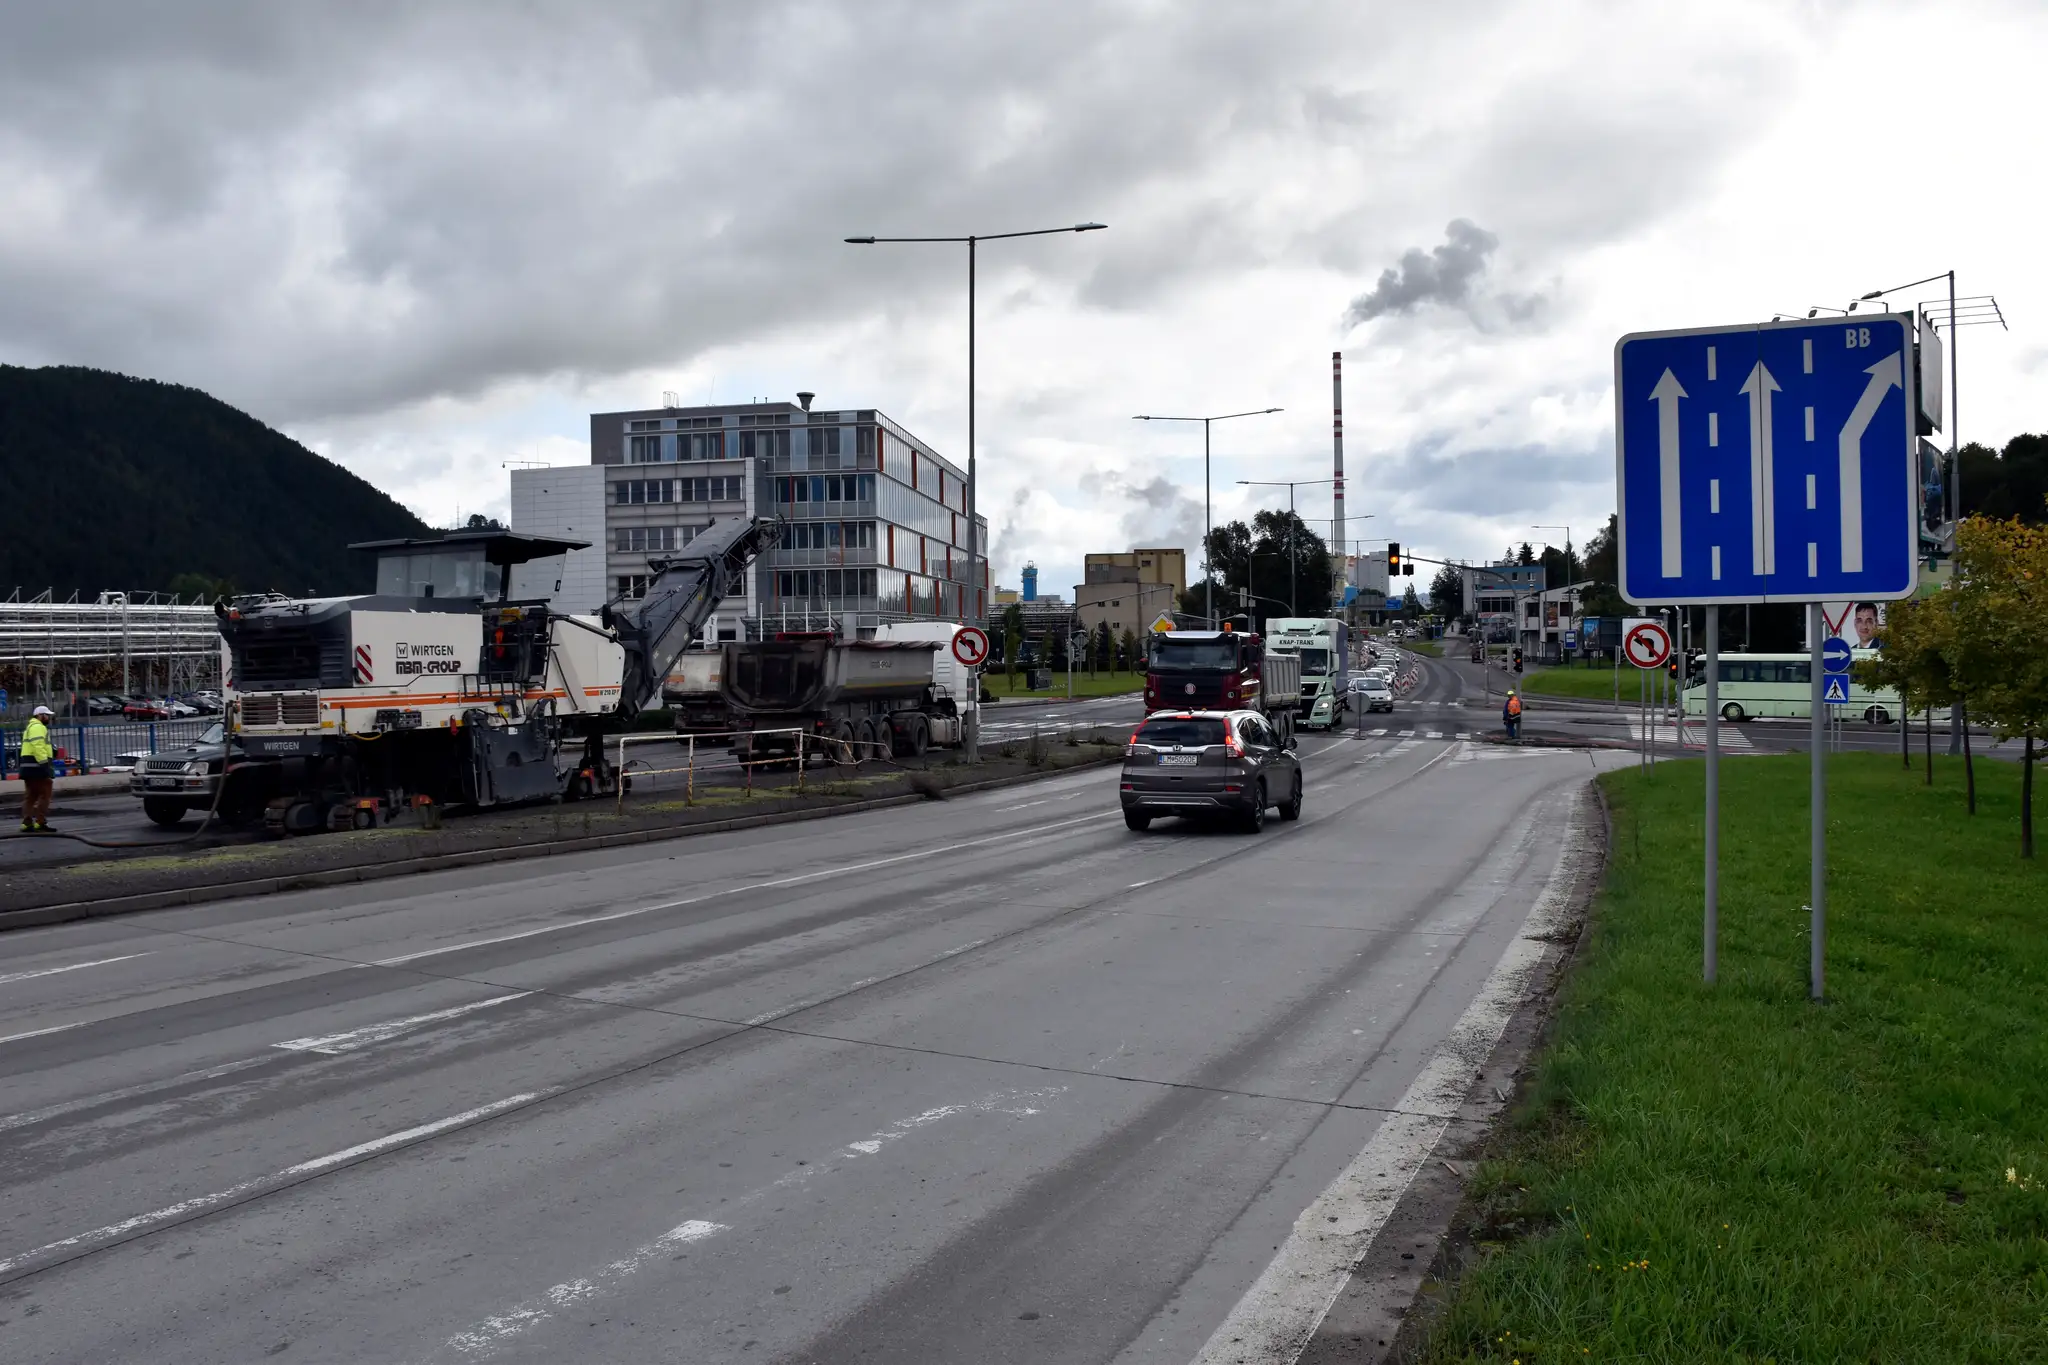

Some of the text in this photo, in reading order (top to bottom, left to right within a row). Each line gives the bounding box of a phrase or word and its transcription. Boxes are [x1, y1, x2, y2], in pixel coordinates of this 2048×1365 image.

[1846, 328, 1870, 348] BB
[411, 645, 454, 656] WIRTGEN
[396, 660, 461, 674] MBM-GROUP
[264, 742, 299, 750] WIRTGEN
